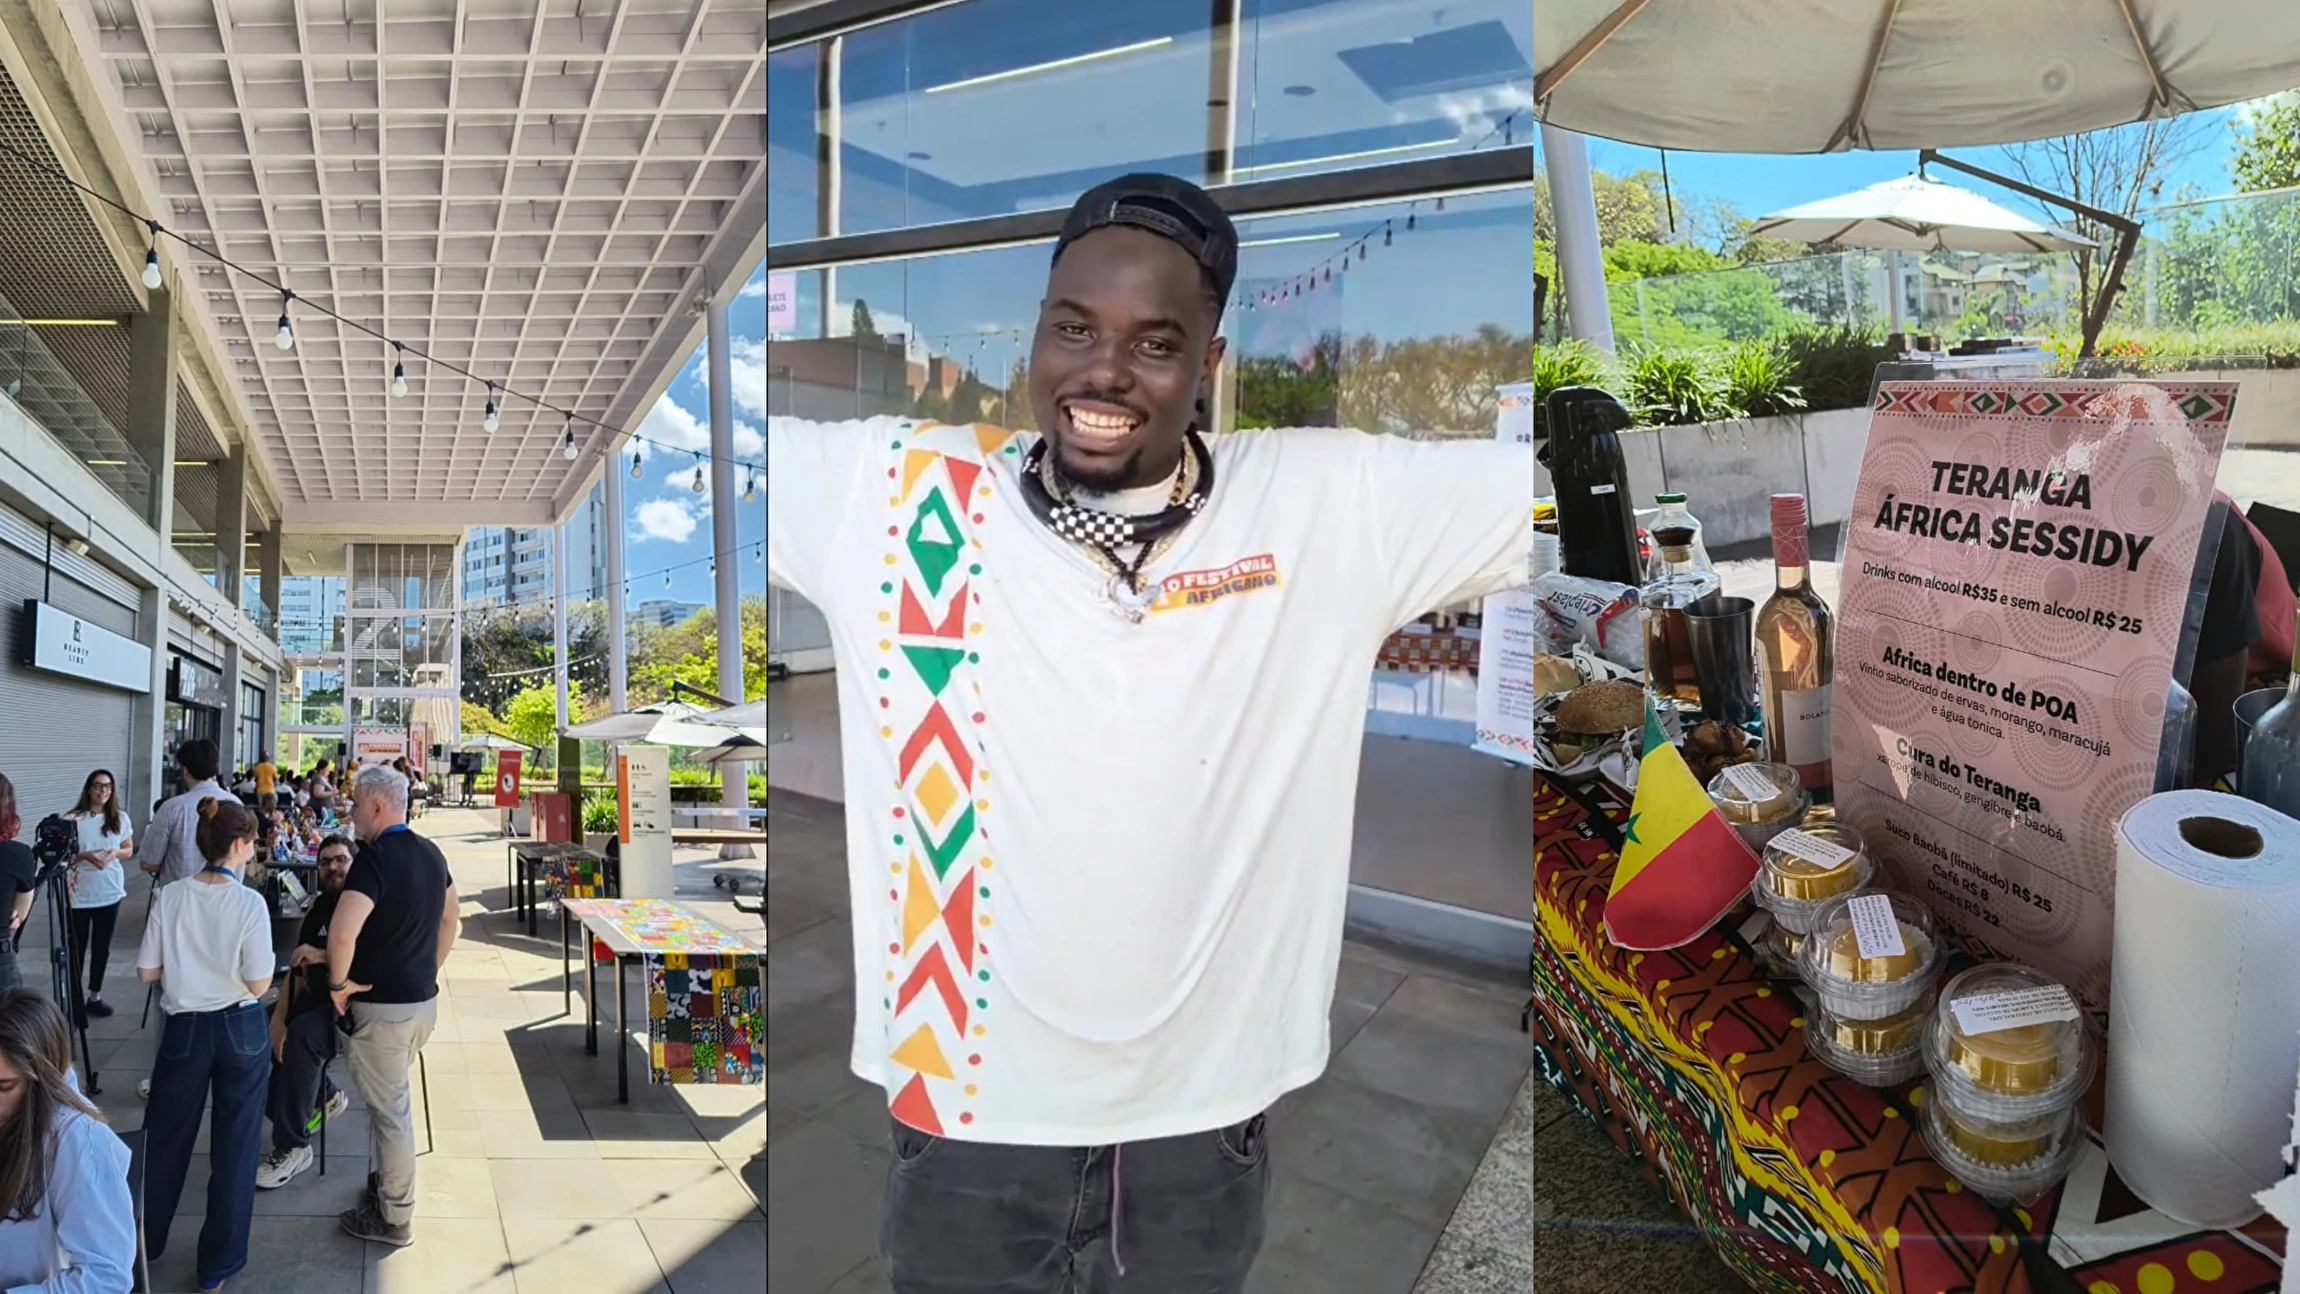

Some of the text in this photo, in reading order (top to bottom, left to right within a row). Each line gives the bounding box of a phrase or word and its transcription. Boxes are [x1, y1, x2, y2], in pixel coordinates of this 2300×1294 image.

[1931, 461, 2092, 510] TERANGA
[1873, 493, 2154, 572] ÁFRICA SESSIDY
[1183, 558, 1272, 586] FESTIVAL
[1186, 574, 1276, 604] AFRICANO
[1862, 561, 2143, 634] Drinks com alcool R$35 e sem alcool R$ 25
[1859, 661, 2111, 756] Vinho saborizado de ervas, morango, maracujá
[1883, 645, 2079, 724] Africa dentro de POA
[1931, 705, 2005, 740] e água tonica.
[1877, 753, 2066, 843] xarope de hibisco, gengibre e baobá.
[1896, 736, 2042, 813] Cura do Teranga
[1885, 819, 2052, 913] Suco Baobá (limitado) R$ 25
[1933, 863, 1989, 901] Café R$ 8
[1927, 879, 2000, 928] Doces R$ 22
